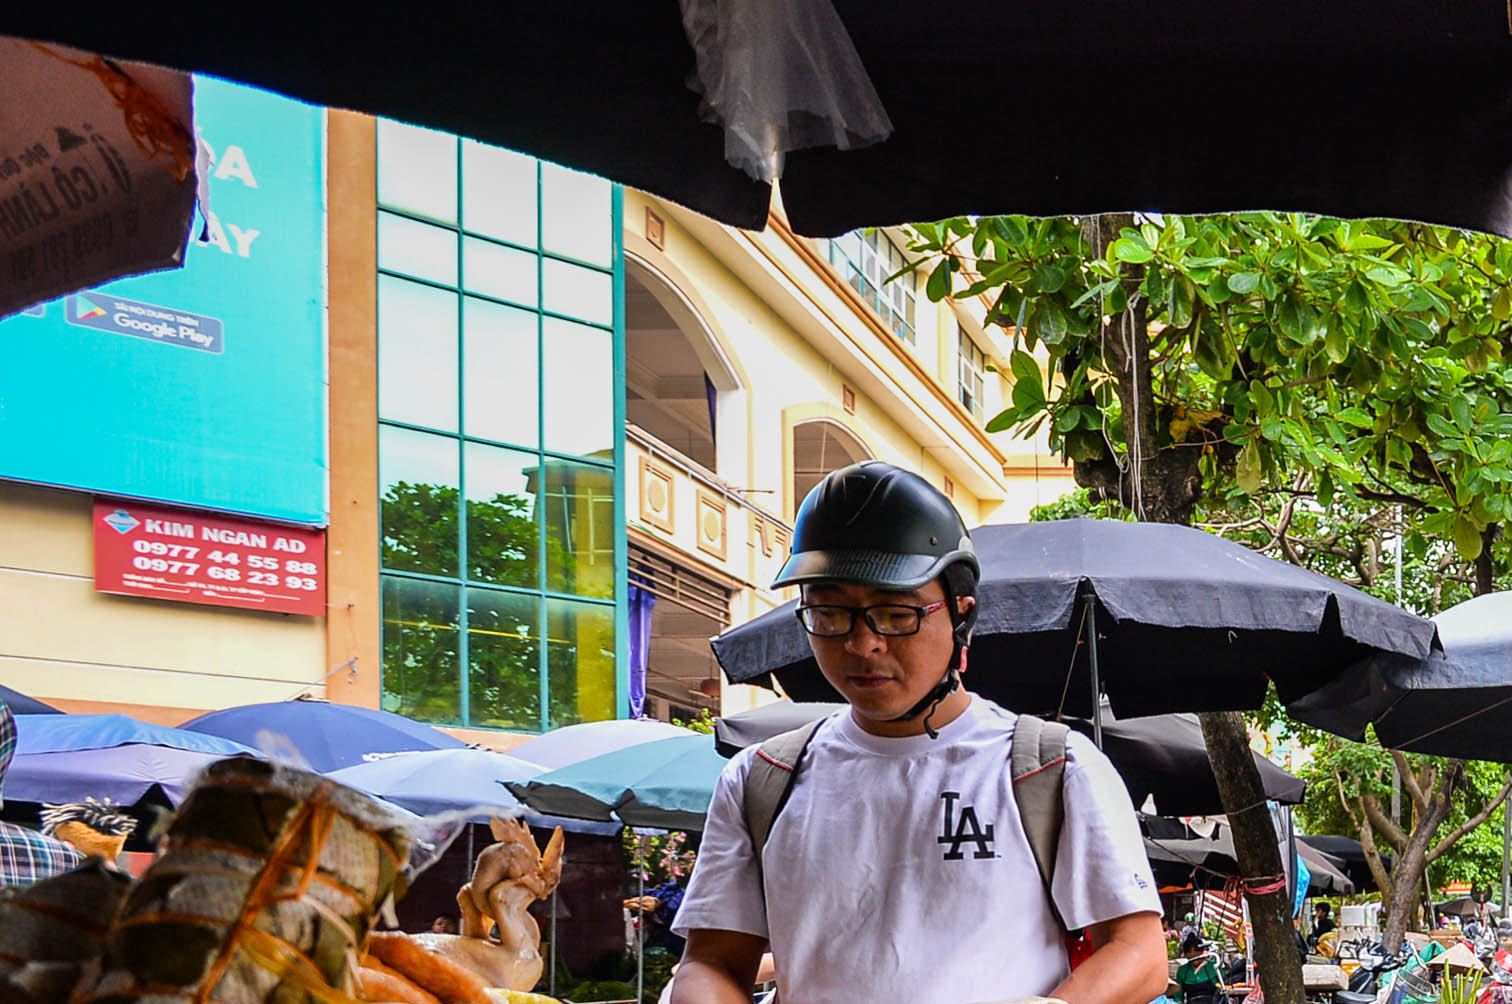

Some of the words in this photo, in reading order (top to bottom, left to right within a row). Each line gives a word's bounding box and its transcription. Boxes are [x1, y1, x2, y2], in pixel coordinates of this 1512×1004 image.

[113, 312, 178, 338] Google
[178, 325, 215, 348] Play
[145, 518, 194, 538] KIM
[202, 525, 267, 549] NGAN
[272, 536, 306, 553] AD
[133, 540, 200, 559] 0977
[207, 550, 239, 565] 44
[248, 555, 279, 570] 55
[285, 560, 318, 575] 88
[133, 556, 200, 576] 0977
[207, 566, 240, 582] 68
[247, 571, 279, 586] 23
[285, 576, 318, 591] 93
[937, 791, 995, 860] LA
